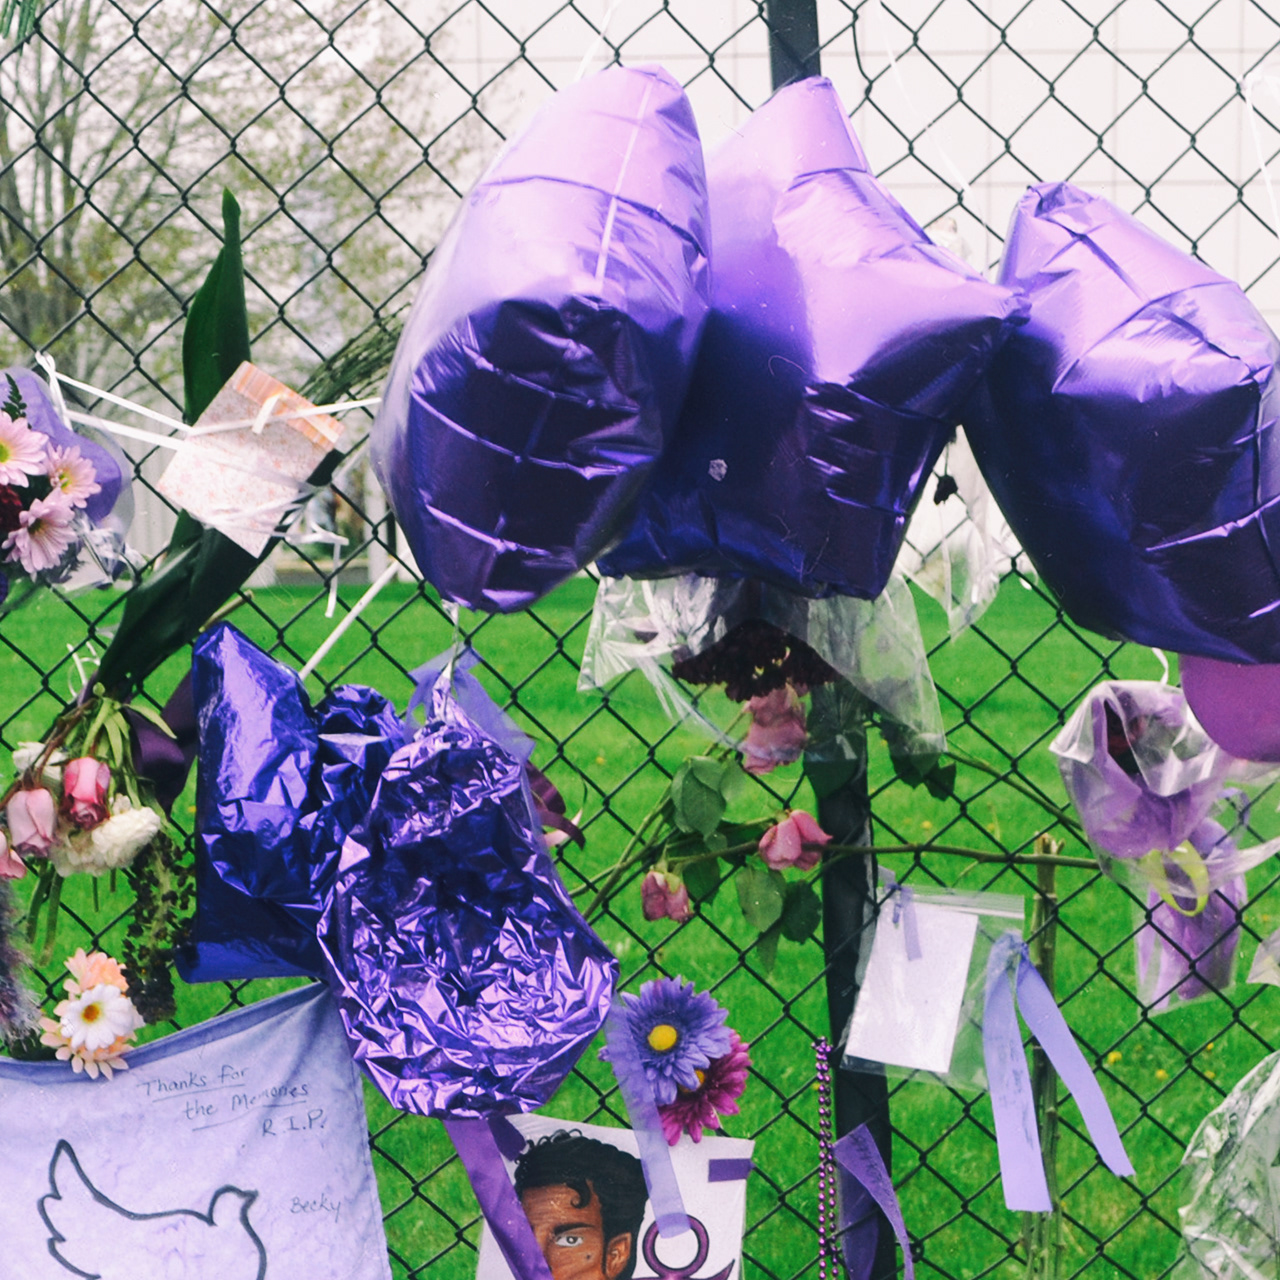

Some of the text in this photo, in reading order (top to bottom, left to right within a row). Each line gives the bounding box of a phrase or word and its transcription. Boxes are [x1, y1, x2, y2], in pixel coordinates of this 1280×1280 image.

[137, 1072, 207, 1096] Thanks
[183, 1100, 218, 1120] the
[290, 1193, 341, 1223] Becky
